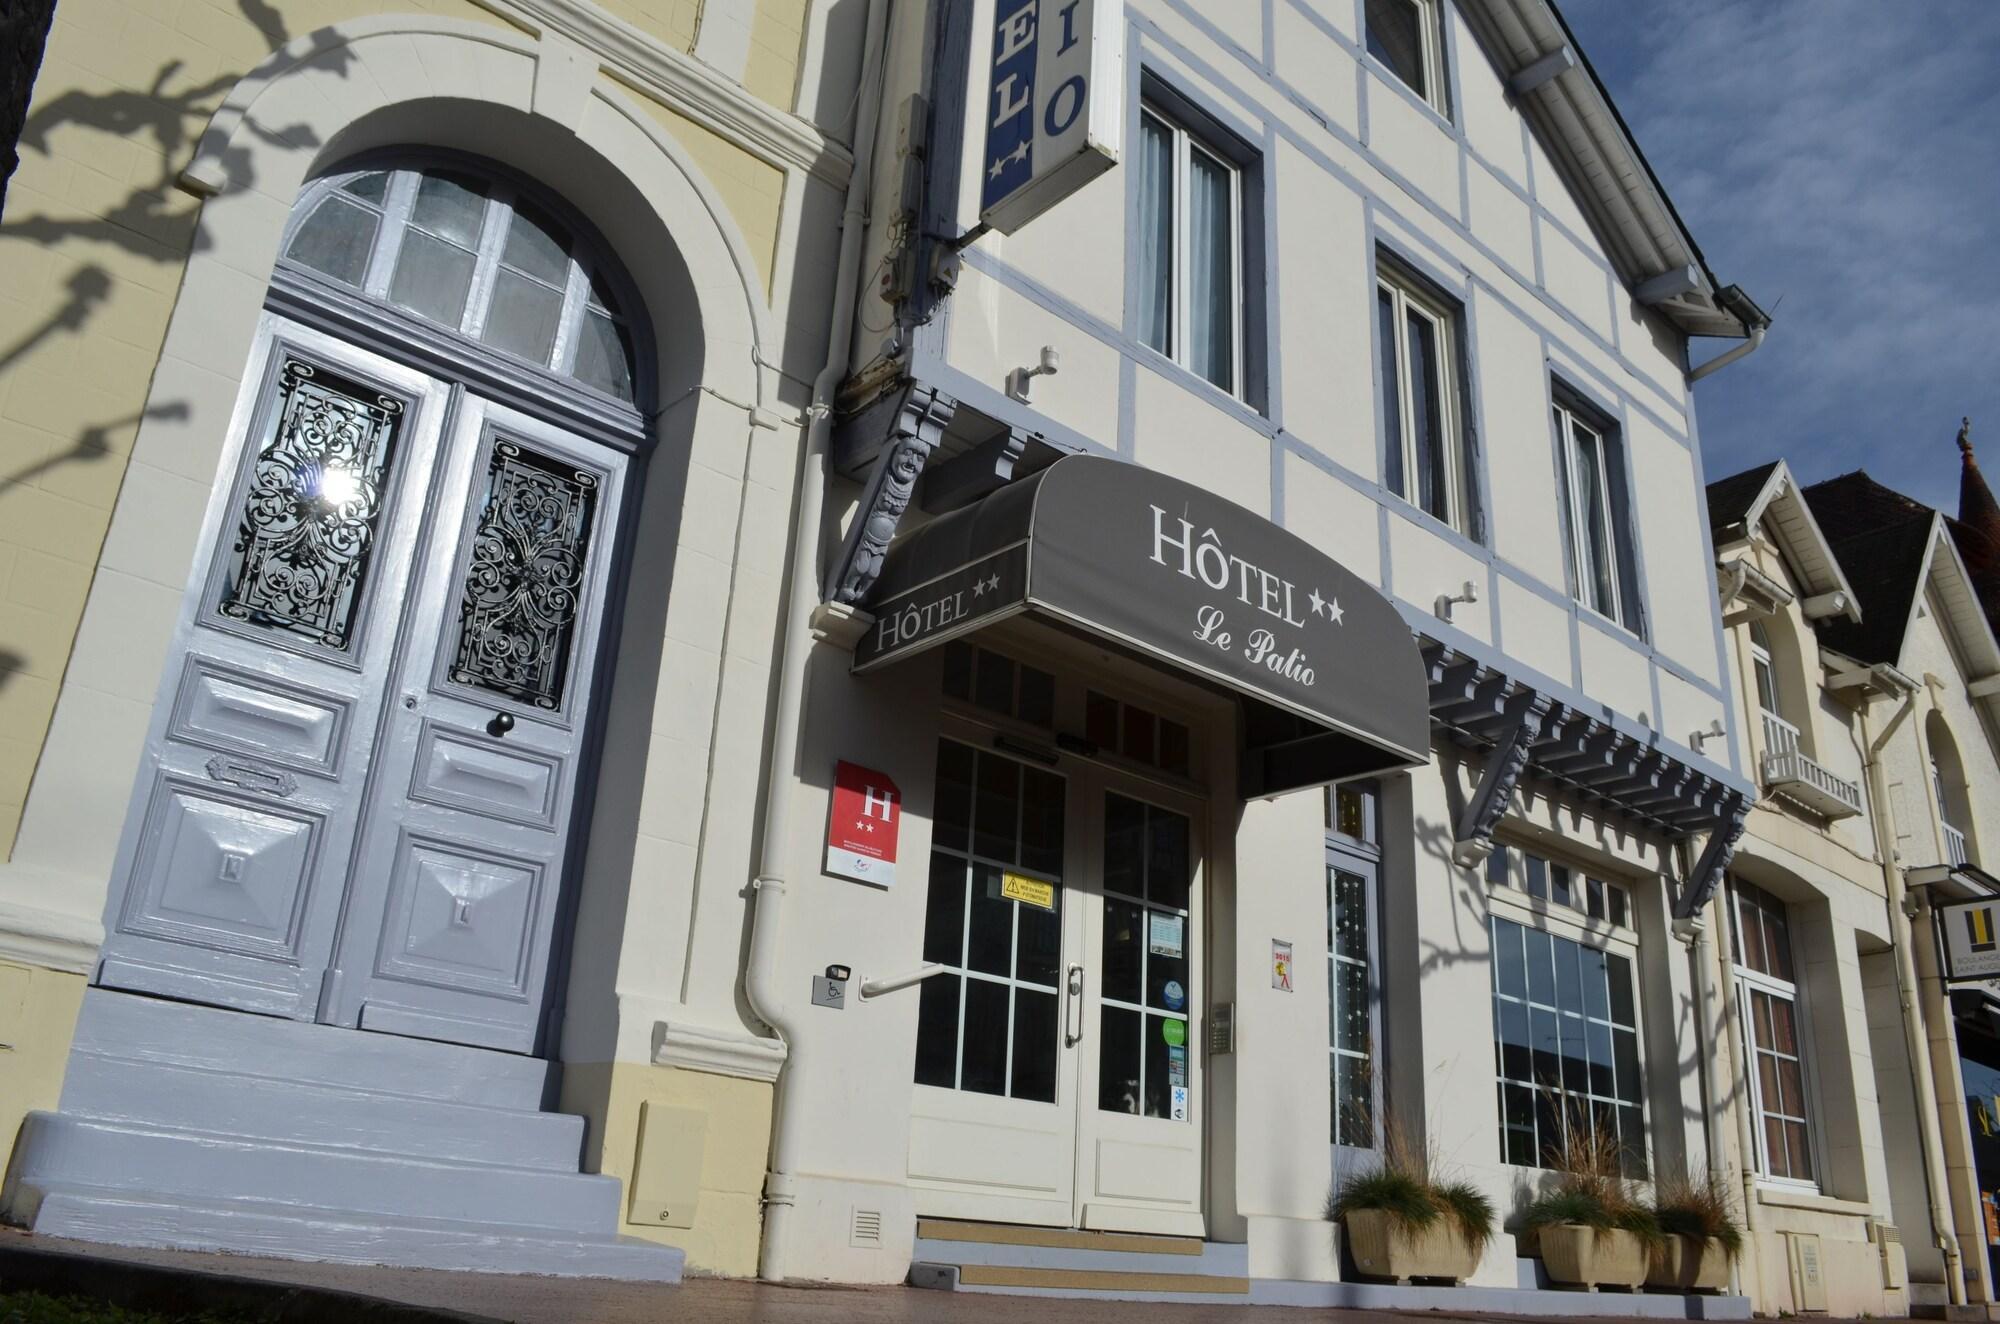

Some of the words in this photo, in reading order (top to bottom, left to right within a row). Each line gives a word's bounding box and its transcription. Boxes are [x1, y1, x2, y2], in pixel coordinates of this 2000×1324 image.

[1150, 504, 1305, 628] HÔTEL
[875, 590, 969, 653] HÔTEL
[1193, 605, 1231, 651] Le
[1244, 628, 1315, 686] Patio
[862, 785, 893, 823] H
